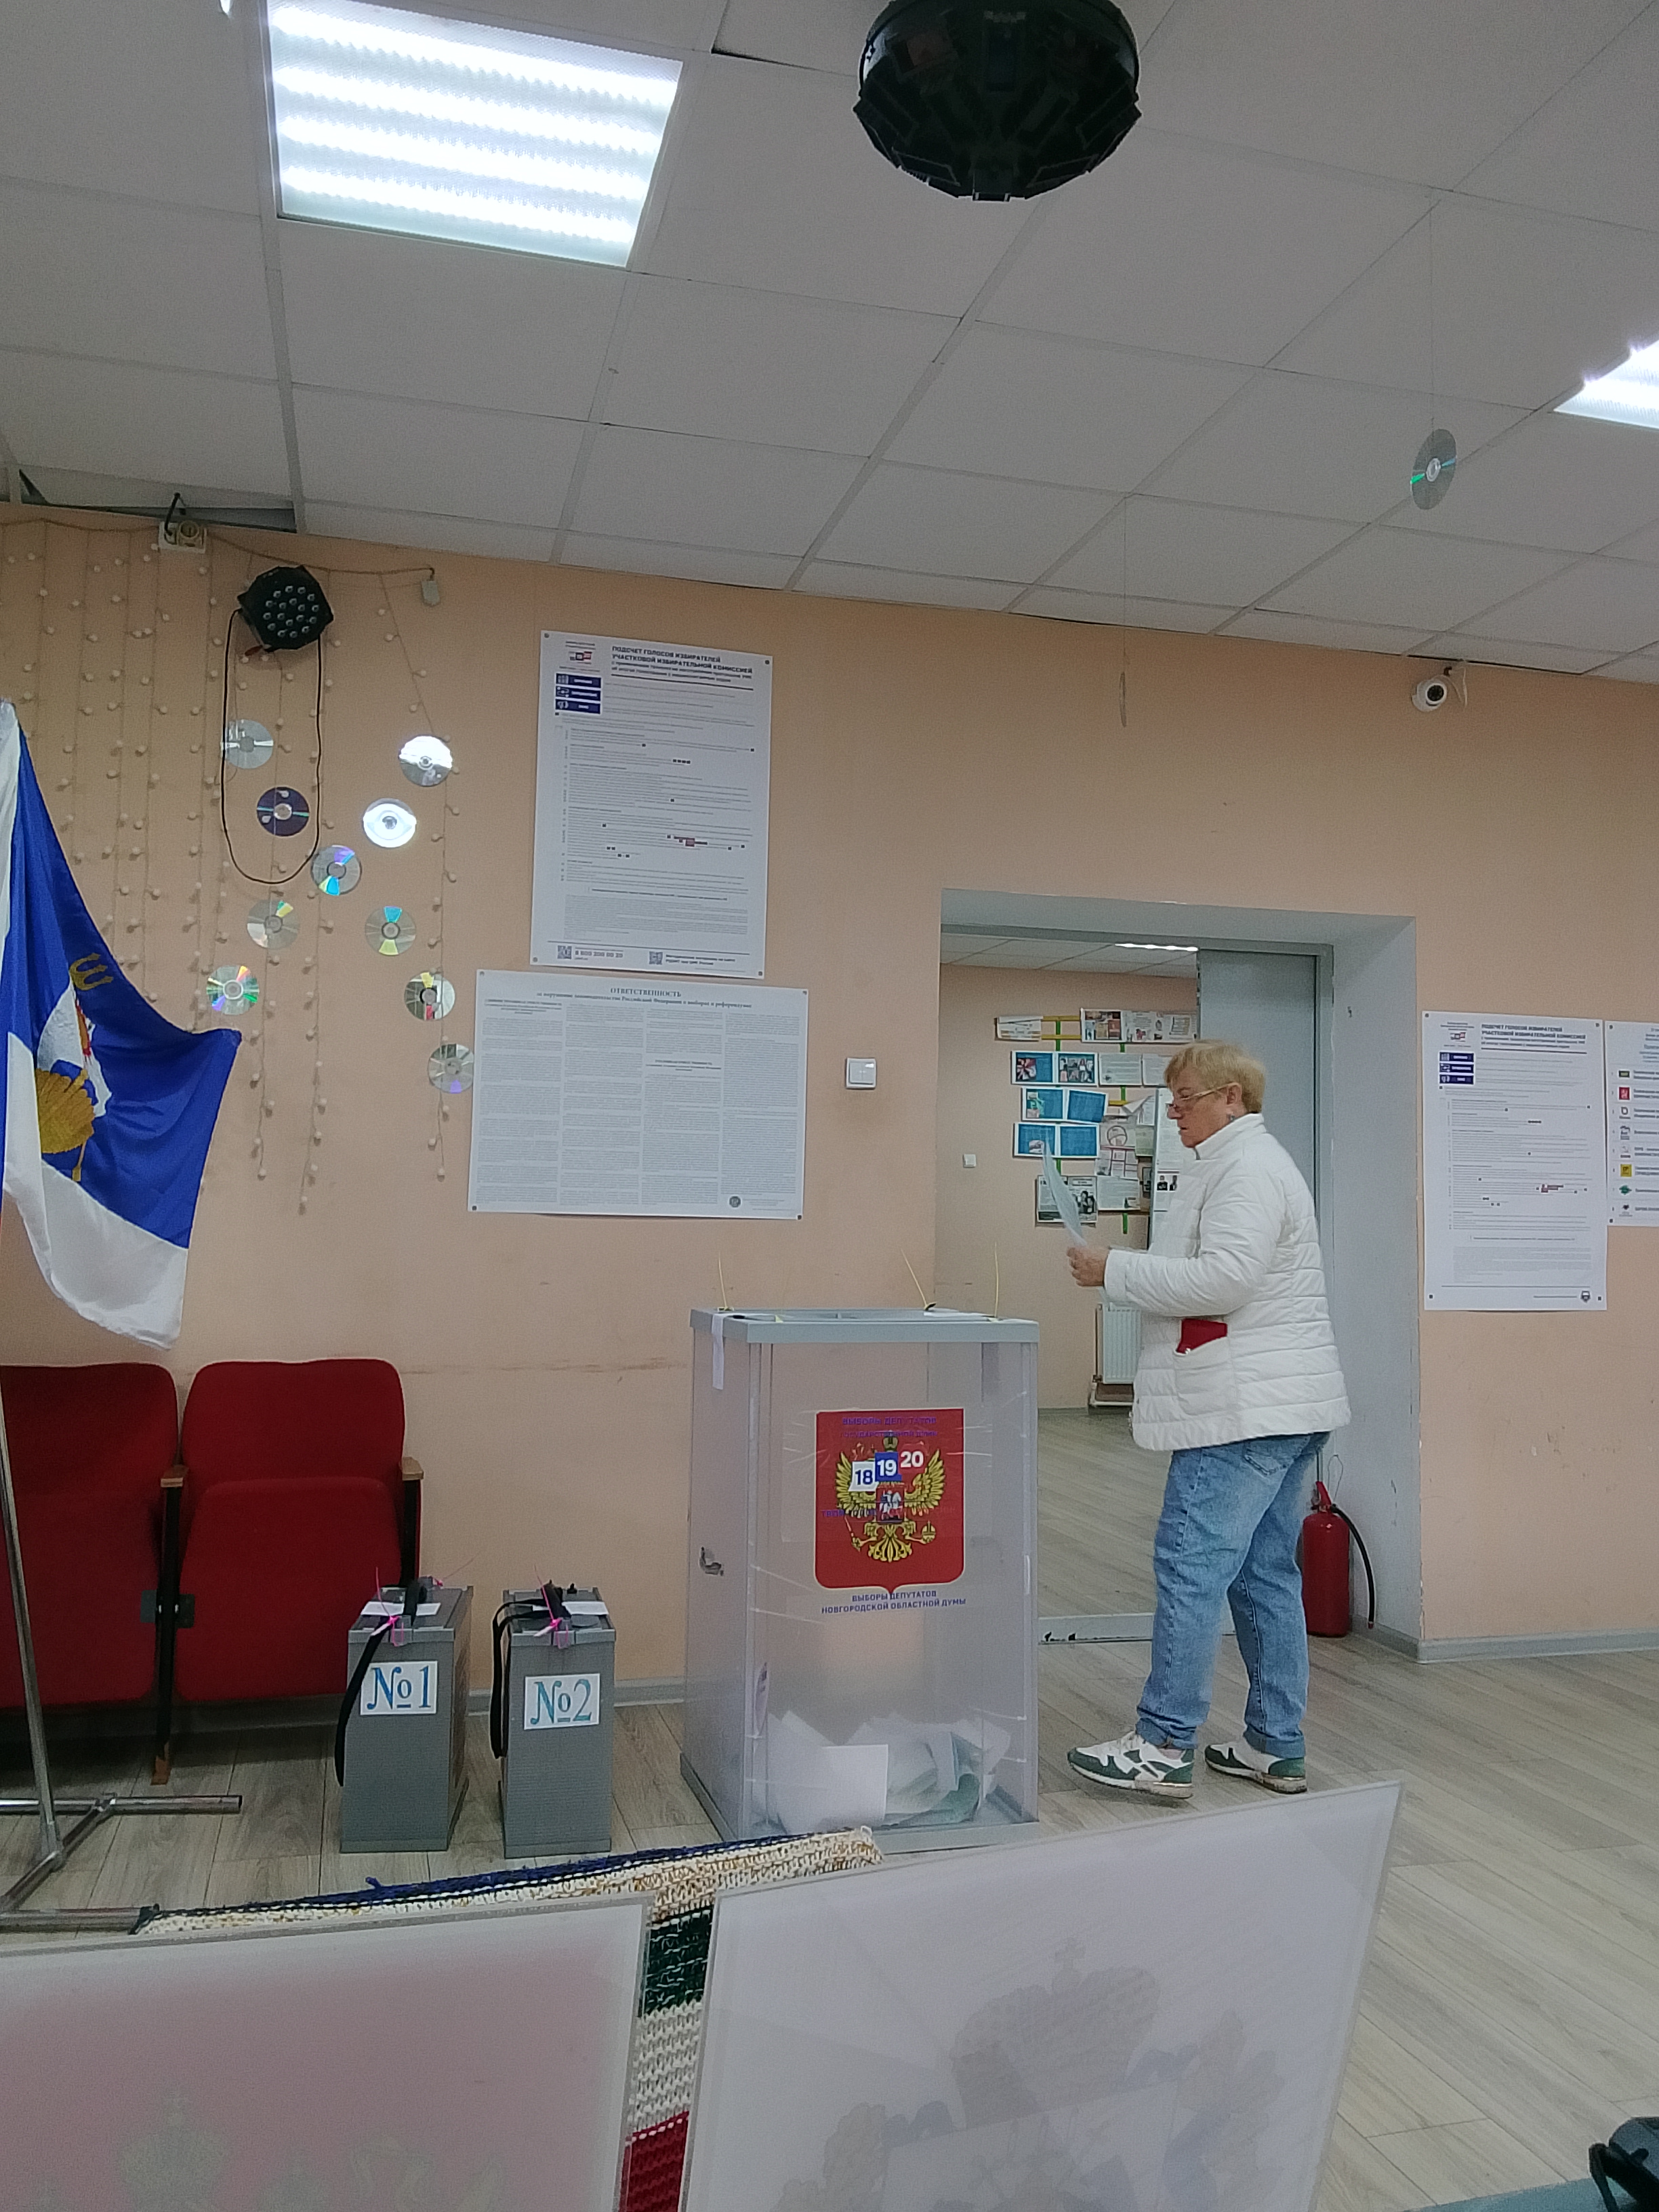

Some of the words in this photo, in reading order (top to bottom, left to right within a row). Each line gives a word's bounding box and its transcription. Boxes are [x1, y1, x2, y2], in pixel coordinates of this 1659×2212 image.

[612, 646, 642, 655] ПОДСЧЕТ
[643, 648, 674, 657] ГОЛОСОВ
[675, 653, 720, 663] ИЗБИРАТЕЛЕЙ
[612, 654, 656, 663] УЧАСТКОВОЙ
[657, 658, 712, 669] ИЗБИРАТЕЛЬНОЙ
[610, 987, 682, 997] ОТВЕТСТВЕННОСТЬ
[877, 1459, 897, 1476] 19
[900, 1451, 924, 1468] 20
[855, 1469, 873, 1485] 18
[852, 1593, 888, 1602] ВЫБОРЫ
[890, 1591, 937, 1600] ДЕПУТАТОВ
[821, 1602, 888, 1614] НОВГОРОДСКОЙ
[890, 1598, 940, 1610] ОБЛАСТНОЙ
[941, 1599, 966, 1607] ДУМЫ
[366, 1665, 432, 1711] №1
[530, 1679, 592, 1725] №2
